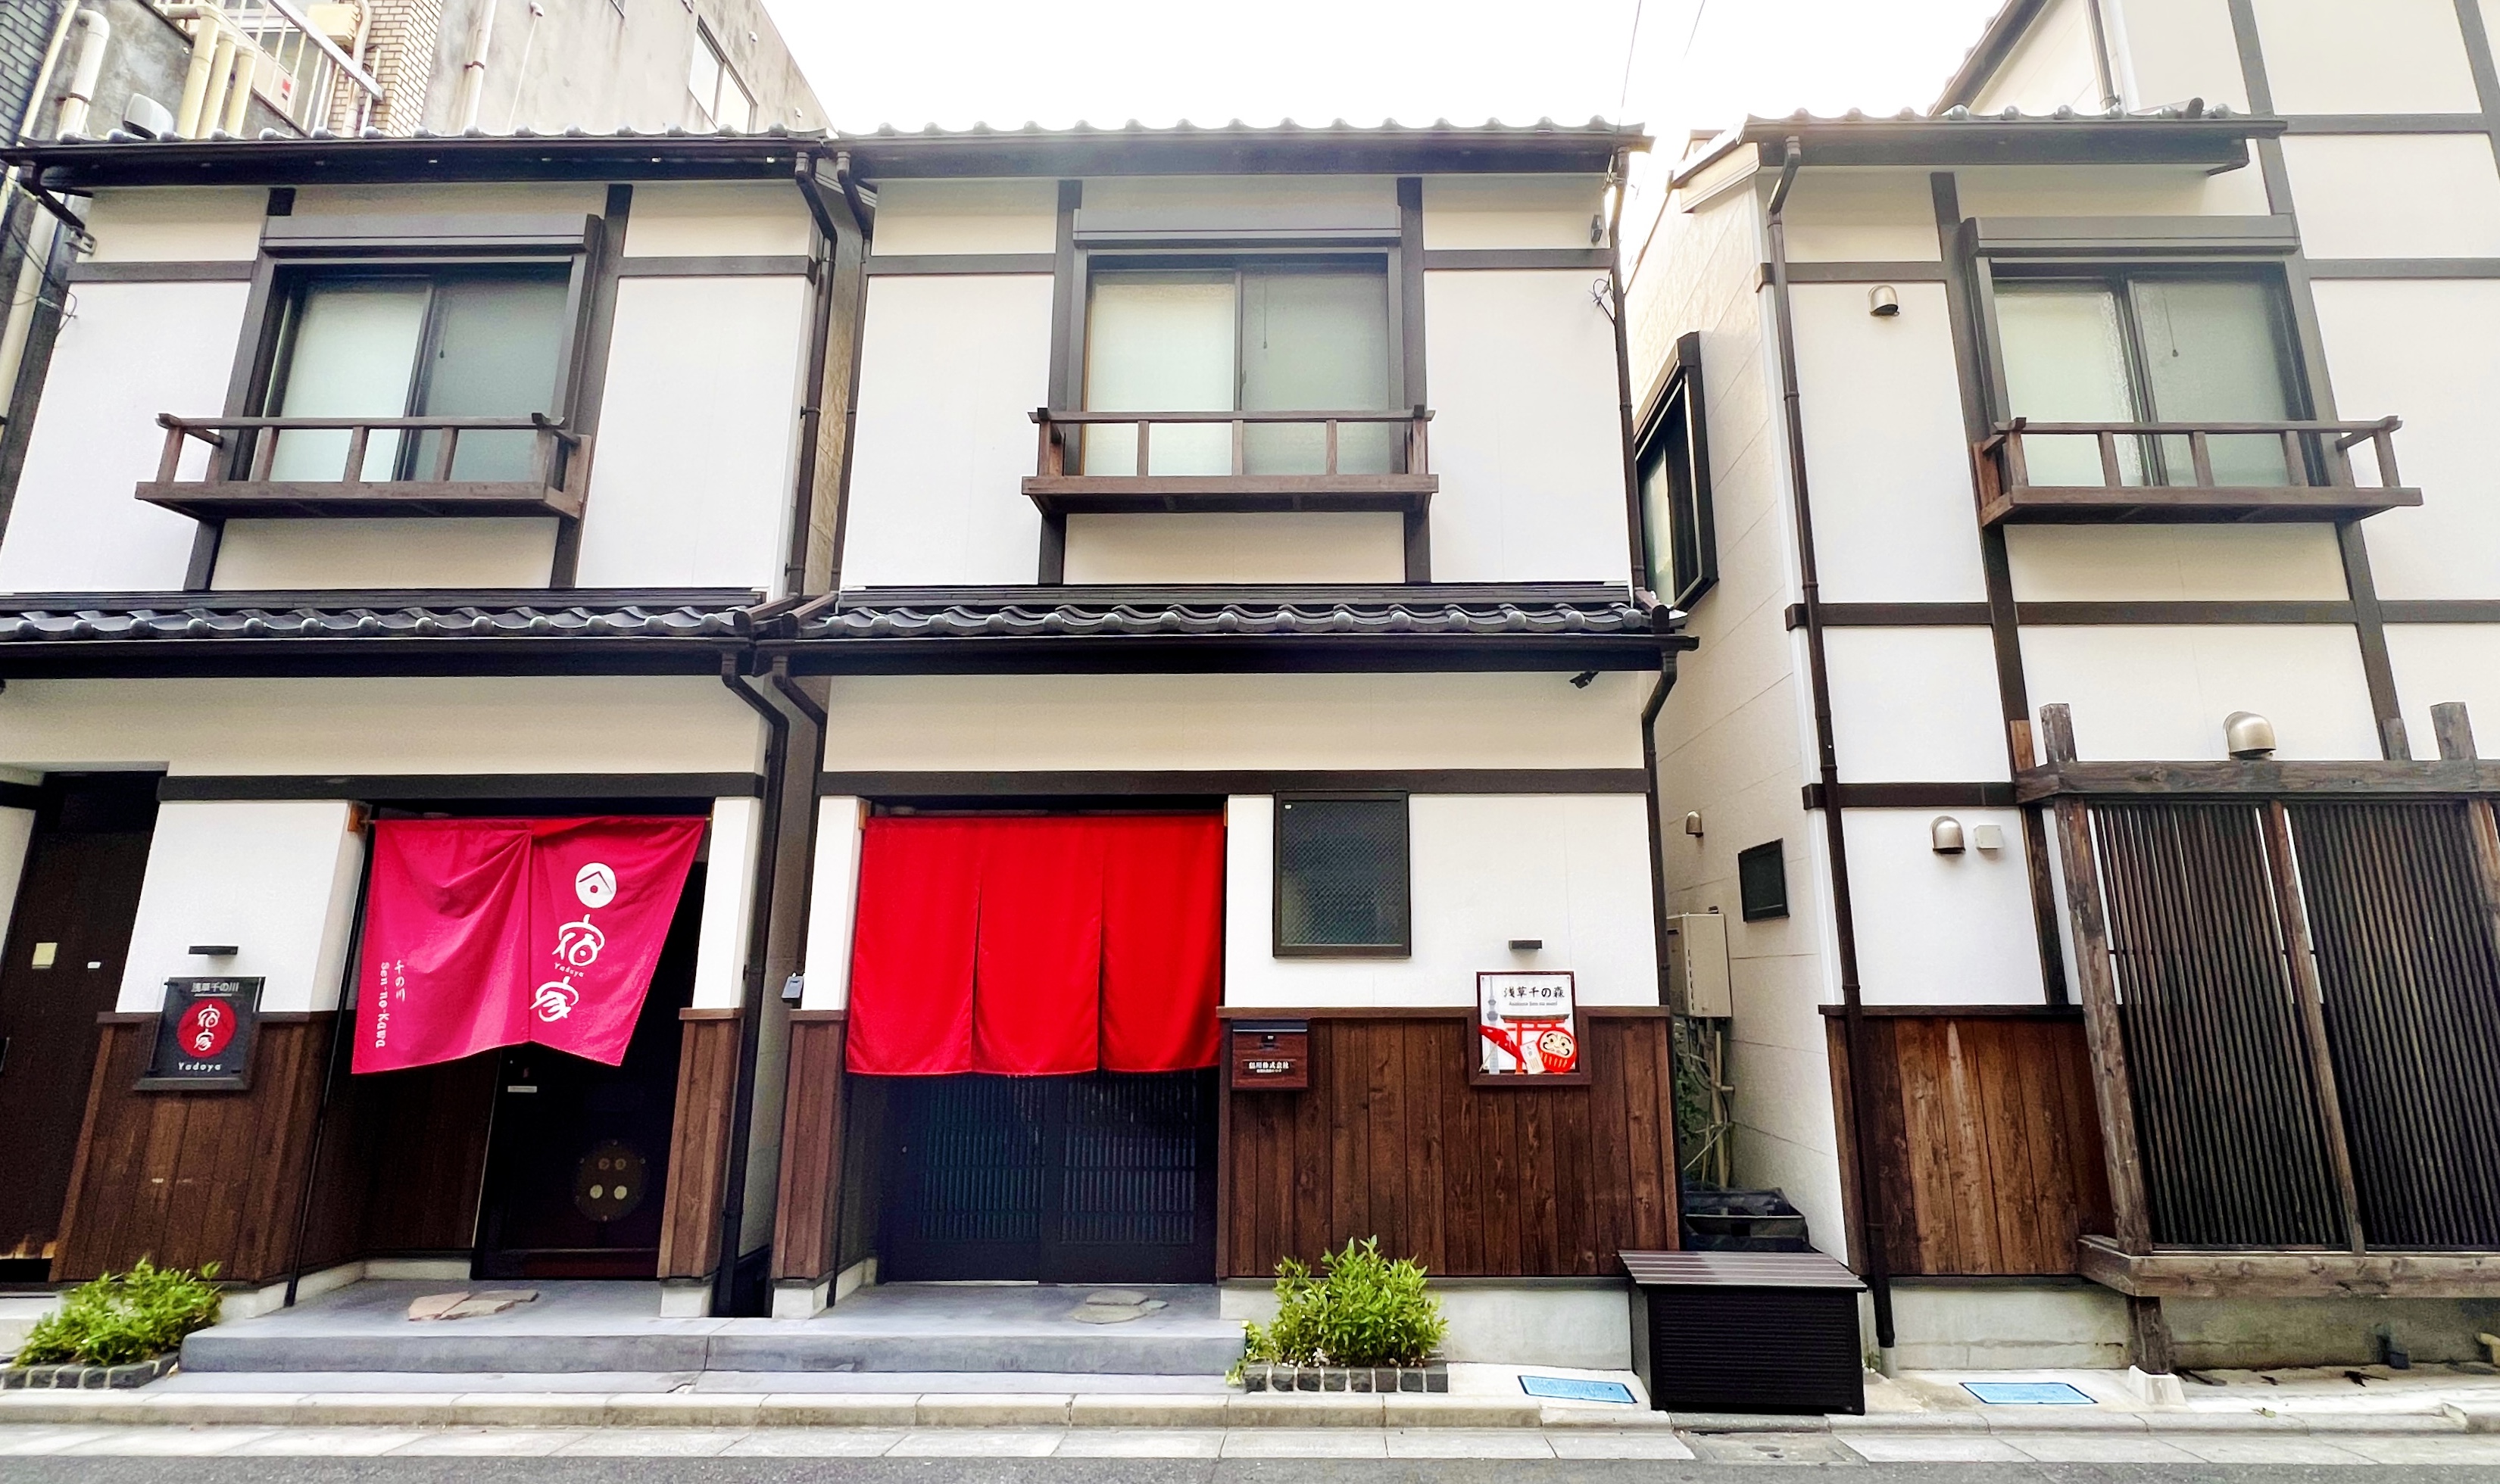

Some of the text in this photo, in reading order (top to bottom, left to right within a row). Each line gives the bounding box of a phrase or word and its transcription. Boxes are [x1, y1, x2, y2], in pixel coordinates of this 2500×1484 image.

[395, 959, 406, 1003] 千の川
[375, 961, 391, 1049] Sen-no-Kawa
[178, 1062, 221, 1073] Yadoya
